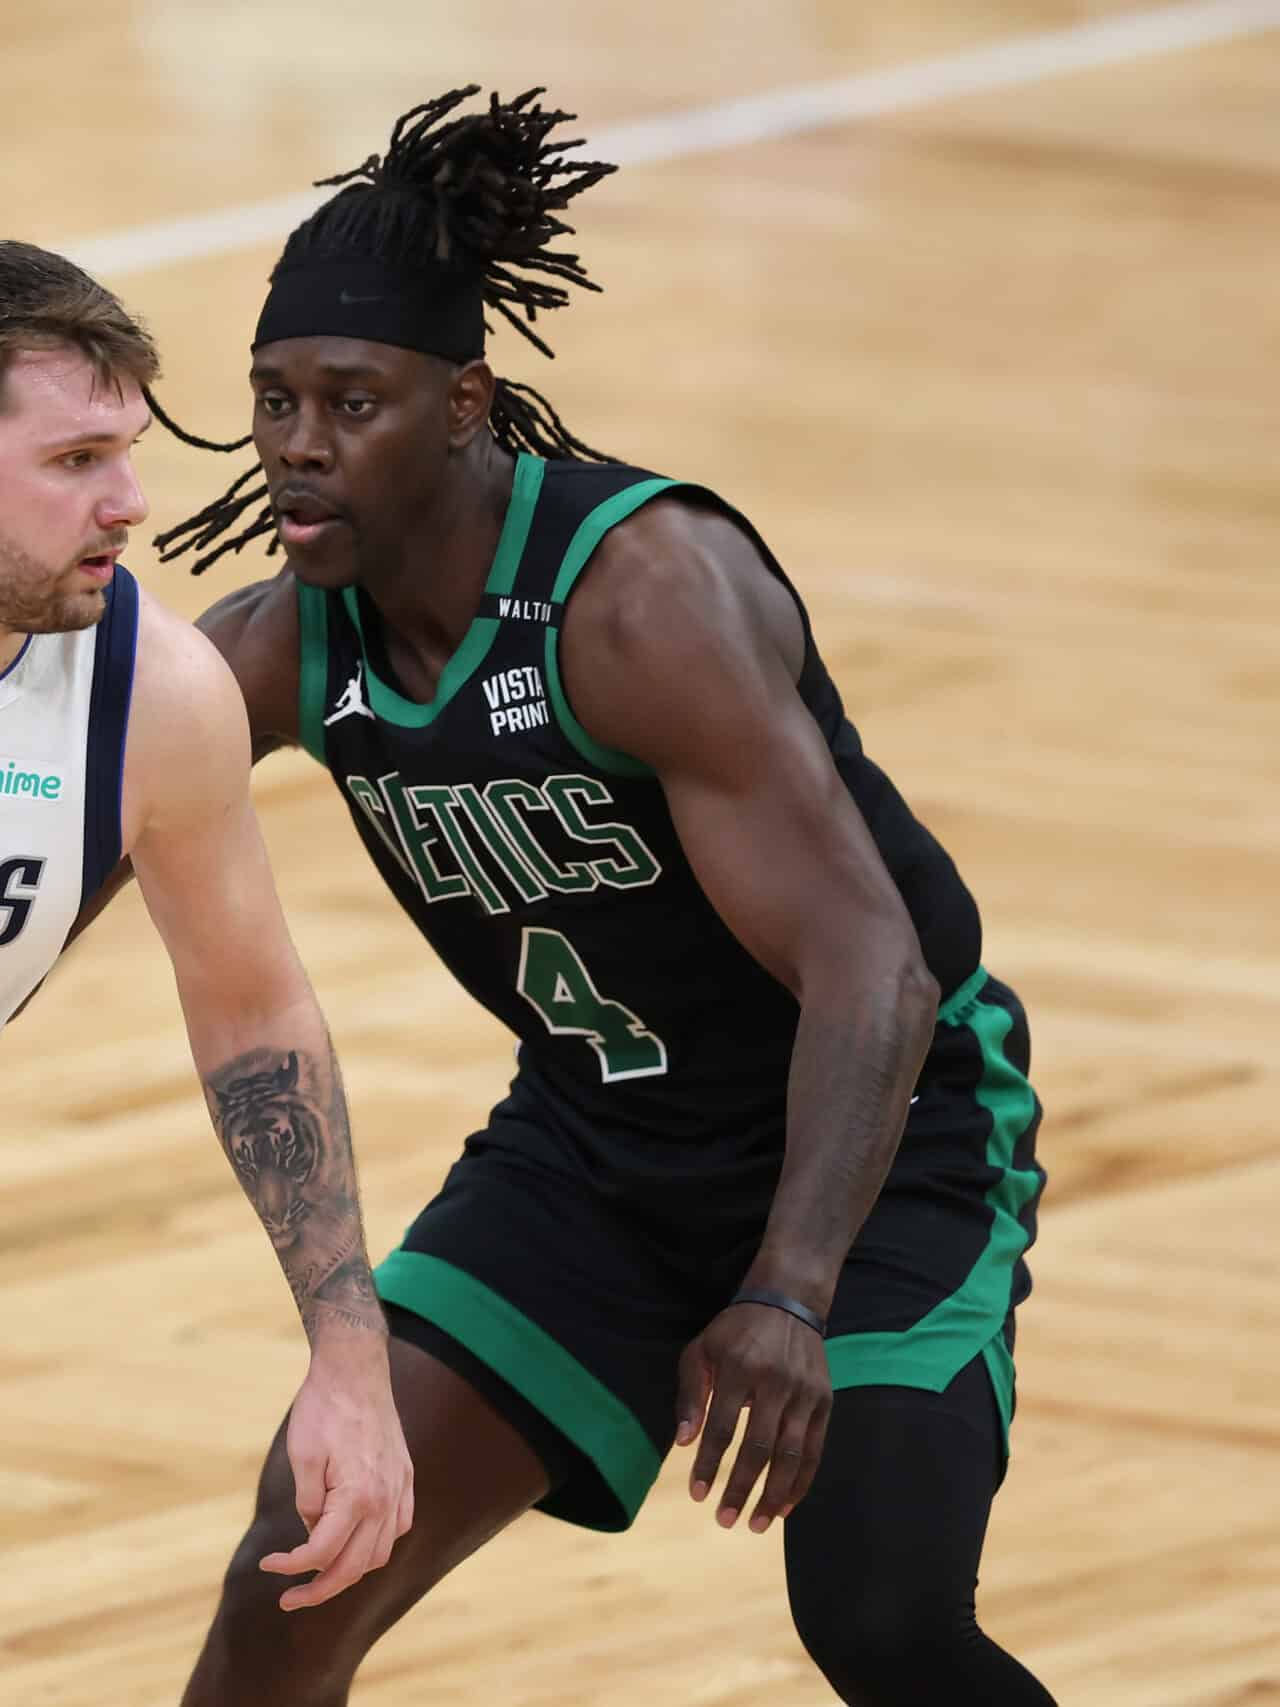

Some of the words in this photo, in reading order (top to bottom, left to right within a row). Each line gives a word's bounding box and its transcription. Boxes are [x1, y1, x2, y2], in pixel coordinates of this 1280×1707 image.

[482, 667, 544, 710] VISTA
[490, 700, 549, 736] PRINT
[346, 772, 662, 915] CETICS
[516, 927, 667, 1083] 4
